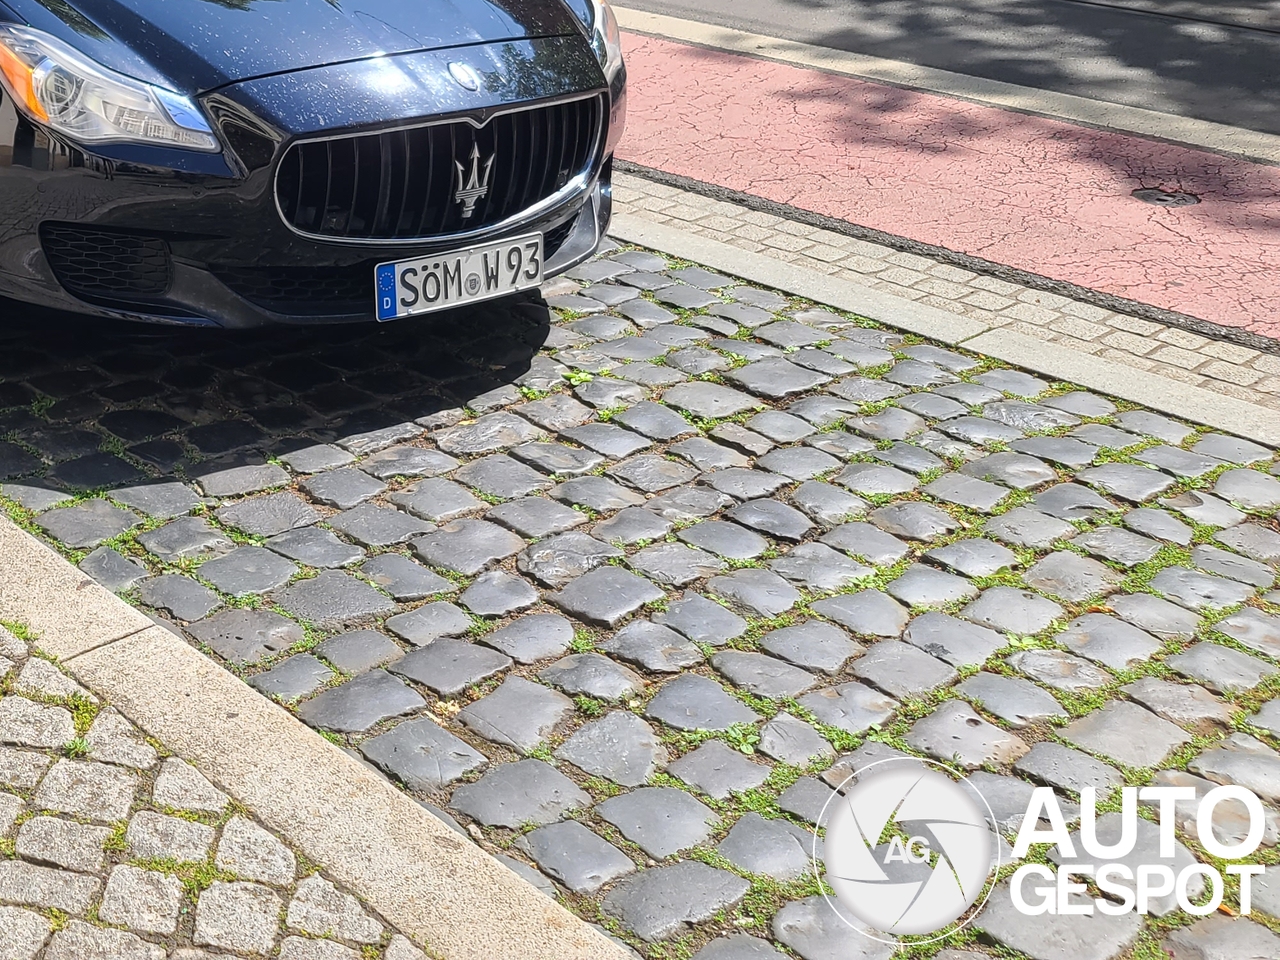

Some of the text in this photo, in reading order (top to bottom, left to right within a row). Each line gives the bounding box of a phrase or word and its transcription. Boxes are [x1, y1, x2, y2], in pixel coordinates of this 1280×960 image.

[400, 242, 539, 307] SÖM W 93
[383, 297, 391, 310] D
